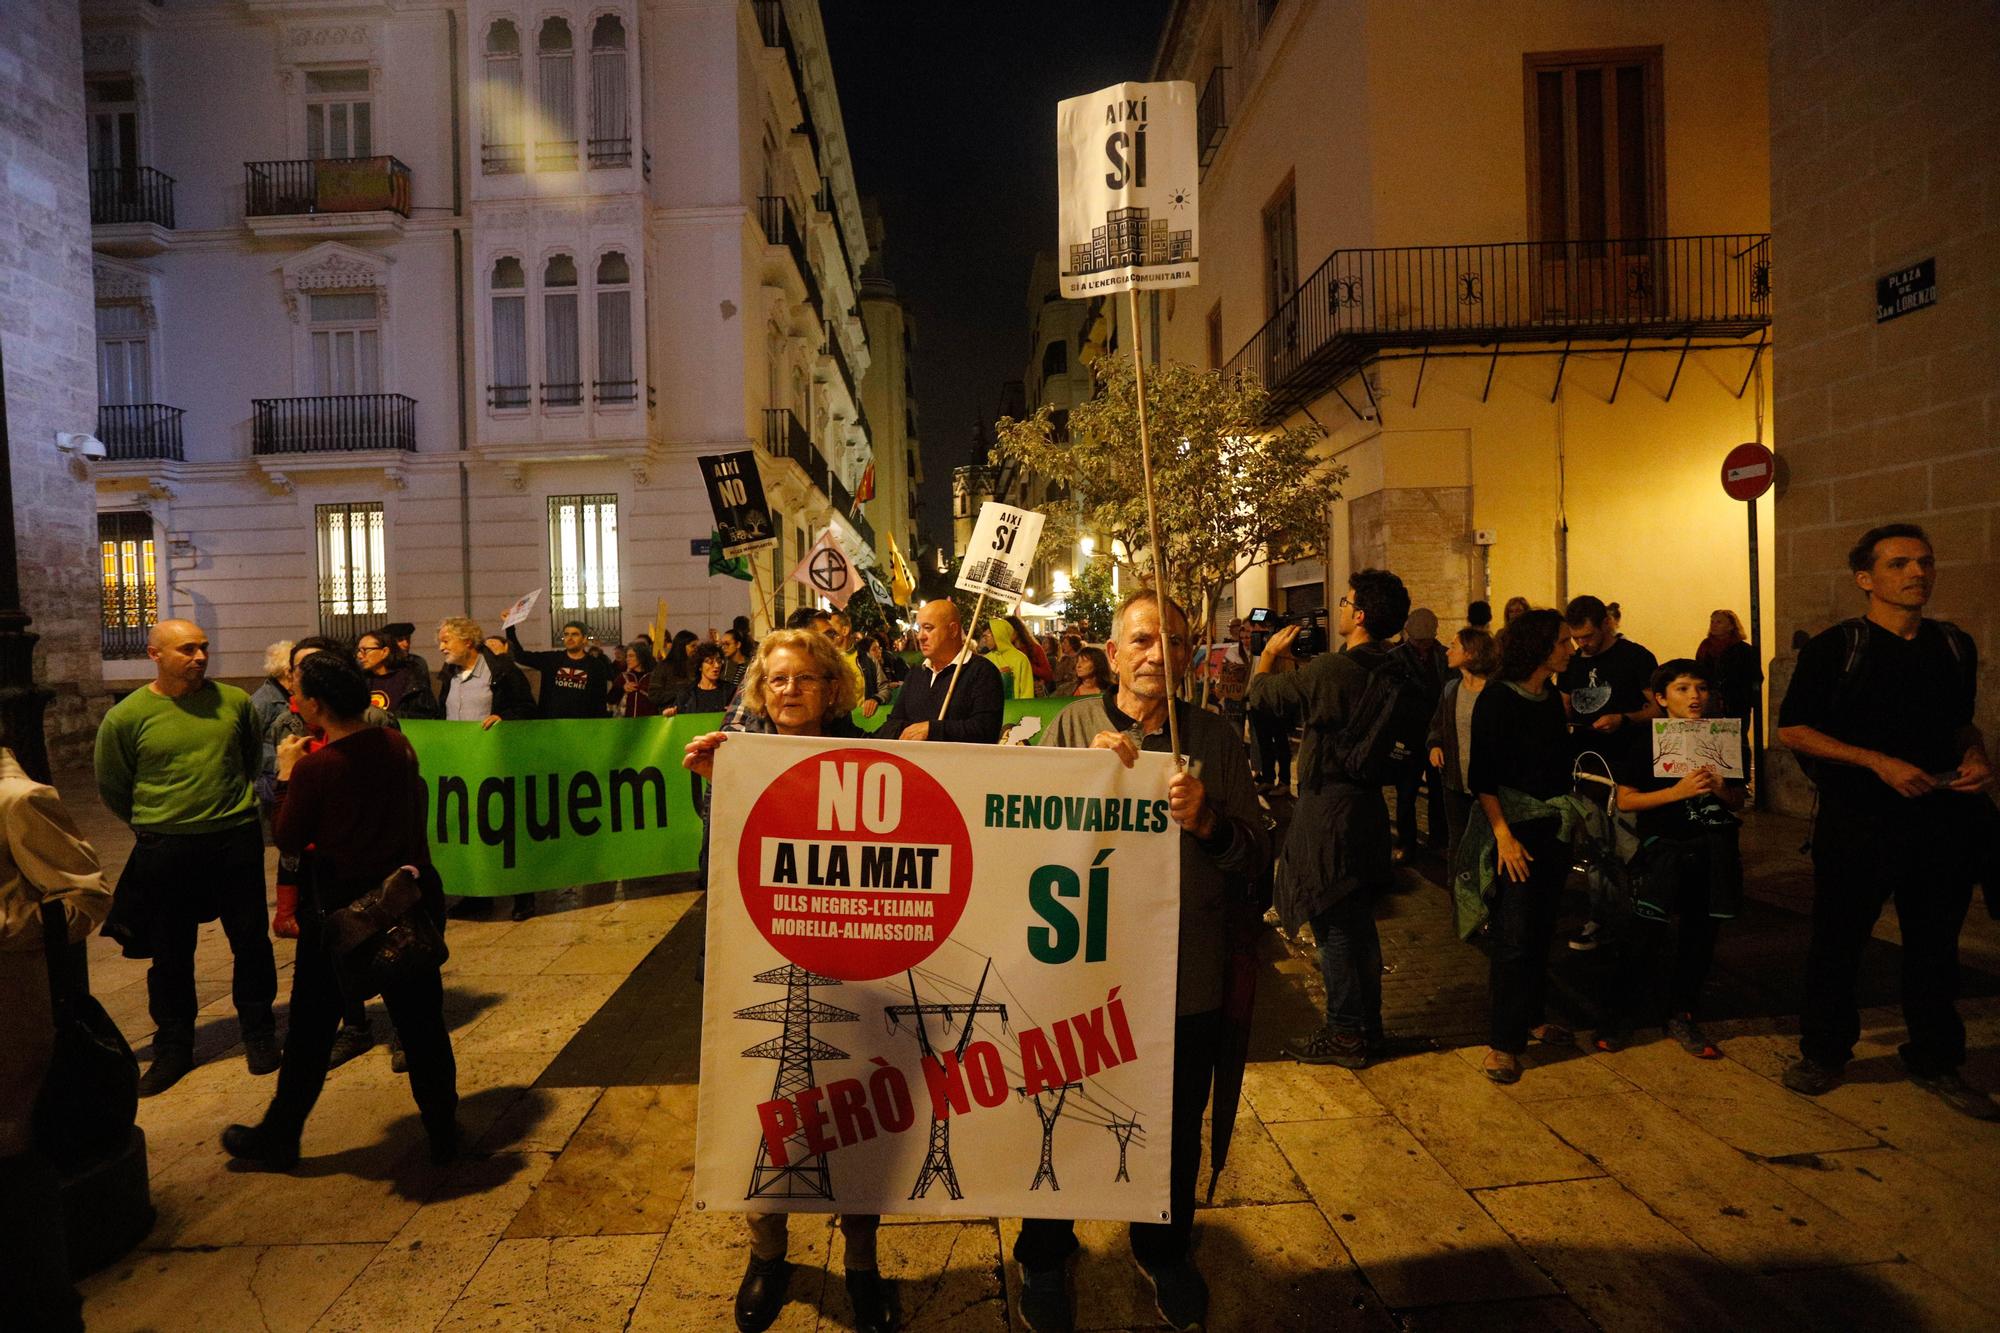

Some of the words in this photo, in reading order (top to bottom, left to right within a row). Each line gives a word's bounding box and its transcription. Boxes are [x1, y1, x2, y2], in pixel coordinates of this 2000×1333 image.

[1107, 96, 1147, 124] AIXÍ
[1105, 124, 1147, 190] SÍ
[1081, 283, 1087, 291] A
[1088, 276, 1129, 289] L'ENERGIA
[1130, 271, 1191, 282] COMUNITARIA
[1889, 267, 1921, 288] PLAZA
[1896, 285, 1937, 313] LORENZO
[714, 458, 740, 477] AIXÍ
[718, 478, 747, 508] NO
[999, 512, 1023, 526] AIXÍ
[992, 525, 1019, 554] SÍ
[817, 760, 903, 833] NO
[417, 766, 667, 869] nquem
[984, 793, 1170, 834] RENOVABLES
[773, 842, 798, 884] A
[807, 844, 851, 887] LA
[860, 846, 939, 890] MAT
[773, 893, 808, 913] ULLS
[811, 896, 934, 918] NEGRES-L'ELIANA
[1027, 848, 1116, 966] SÍ
[771, 920, 934, 942] MORELLA-ALMASSORA
[756, 1055, 915, 1168] PERÒ
[920, 1040, 1009, 1122] NO
[1018, 985, 1138, 1096] AIXÍ
